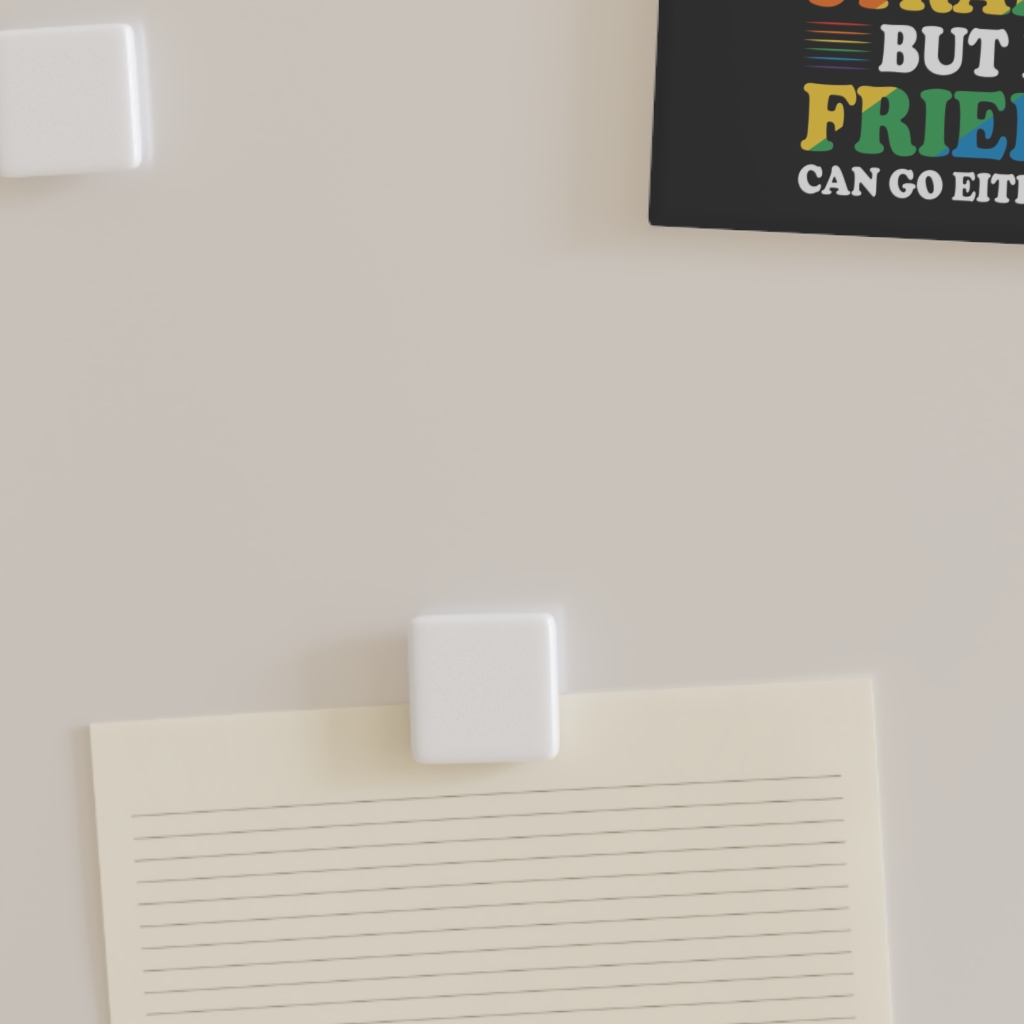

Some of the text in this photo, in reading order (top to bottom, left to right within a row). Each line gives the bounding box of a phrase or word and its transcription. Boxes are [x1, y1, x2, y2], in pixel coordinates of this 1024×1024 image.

[878, 24, 1009, 77] BUT
[798, 164, 880, 197] CAN
[889, 168, 943, 200] GO
